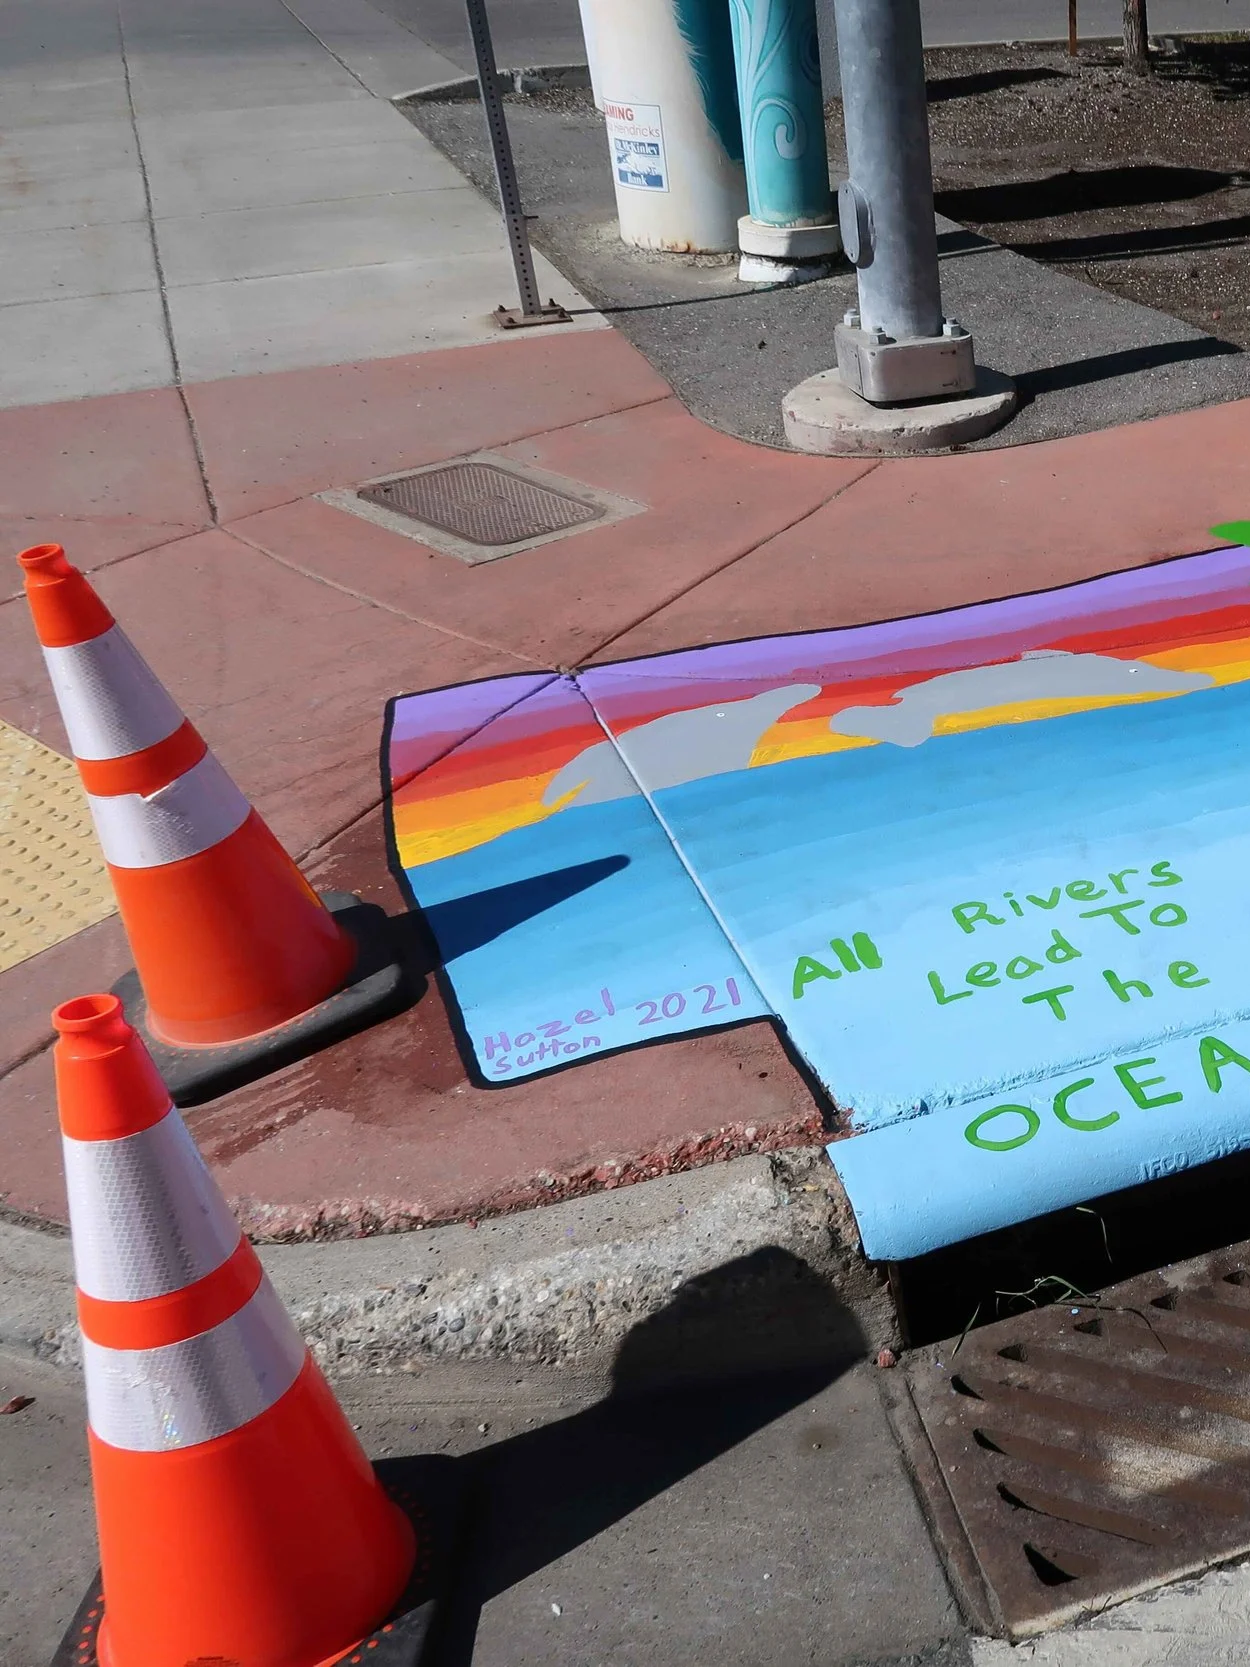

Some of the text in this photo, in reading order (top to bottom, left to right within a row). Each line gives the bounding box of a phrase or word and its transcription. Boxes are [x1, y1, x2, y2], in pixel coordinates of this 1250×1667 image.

[793, 860, 1184, 999] All Rivers
[927, 929, 1083, 1005] Lead
[484, 977, 742, 1060] Hazel 2021
[1022, 959, 1211, 1021] The
